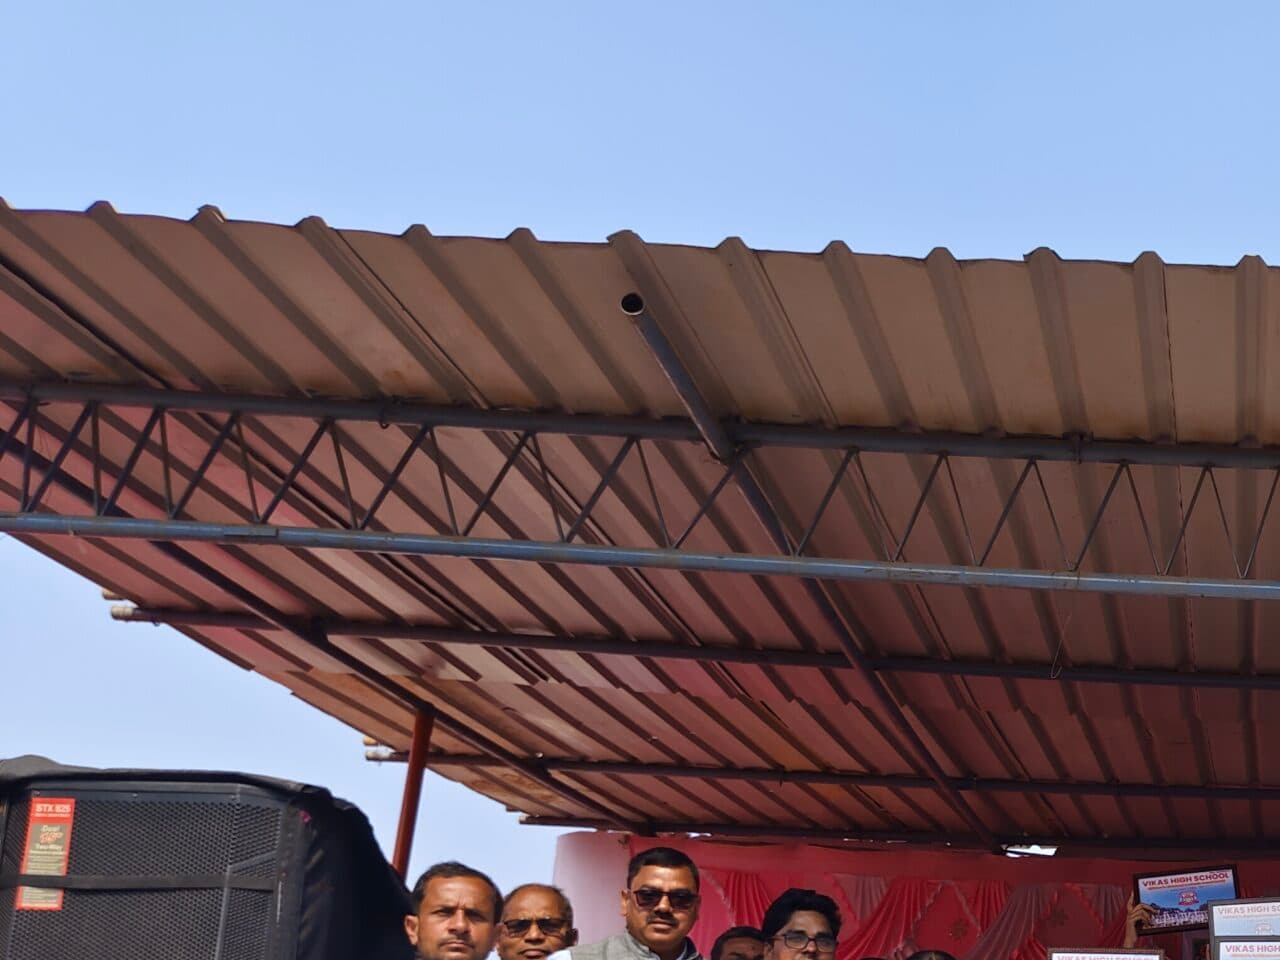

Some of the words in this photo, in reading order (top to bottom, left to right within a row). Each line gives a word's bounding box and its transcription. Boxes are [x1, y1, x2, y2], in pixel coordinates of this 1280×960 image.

[1142, 879, 1169, 887] VIKAS
[1170, 876, 1192, 885] HIGH
[1193, 872, 1229, 882] SCHOOL
[1217, 905, 1246, 914] VIKAS
[1247, 904, 1269, 913] HIGH
[1225, 944, 1255, 953] VIKAS
[1256, 944, 1280, 953] HIGH
